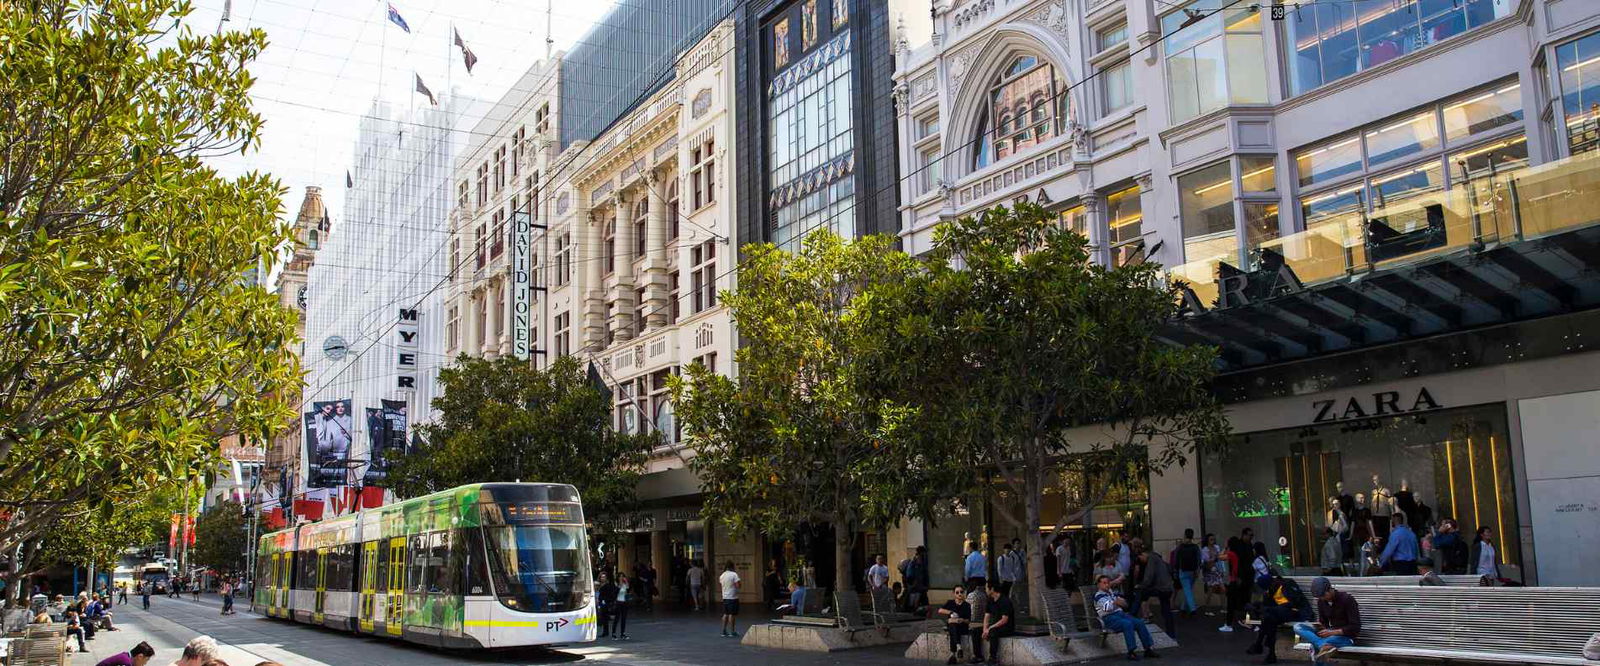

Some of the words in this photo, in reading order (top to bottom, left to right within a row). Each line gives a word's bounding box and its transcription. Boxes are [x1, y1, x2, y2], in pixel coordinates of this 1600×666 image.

[1272, 7, 1283, 18] 39
[516, 221, 528, 284] DAVID
[1178, 264, 1304, 317] ARA
[398, 308, 417, 388] MYER
[516, 288, 528, 355] JONES
[1313, 387, 1444, 423] ZARA
[546, 621, 561, 632] PT
